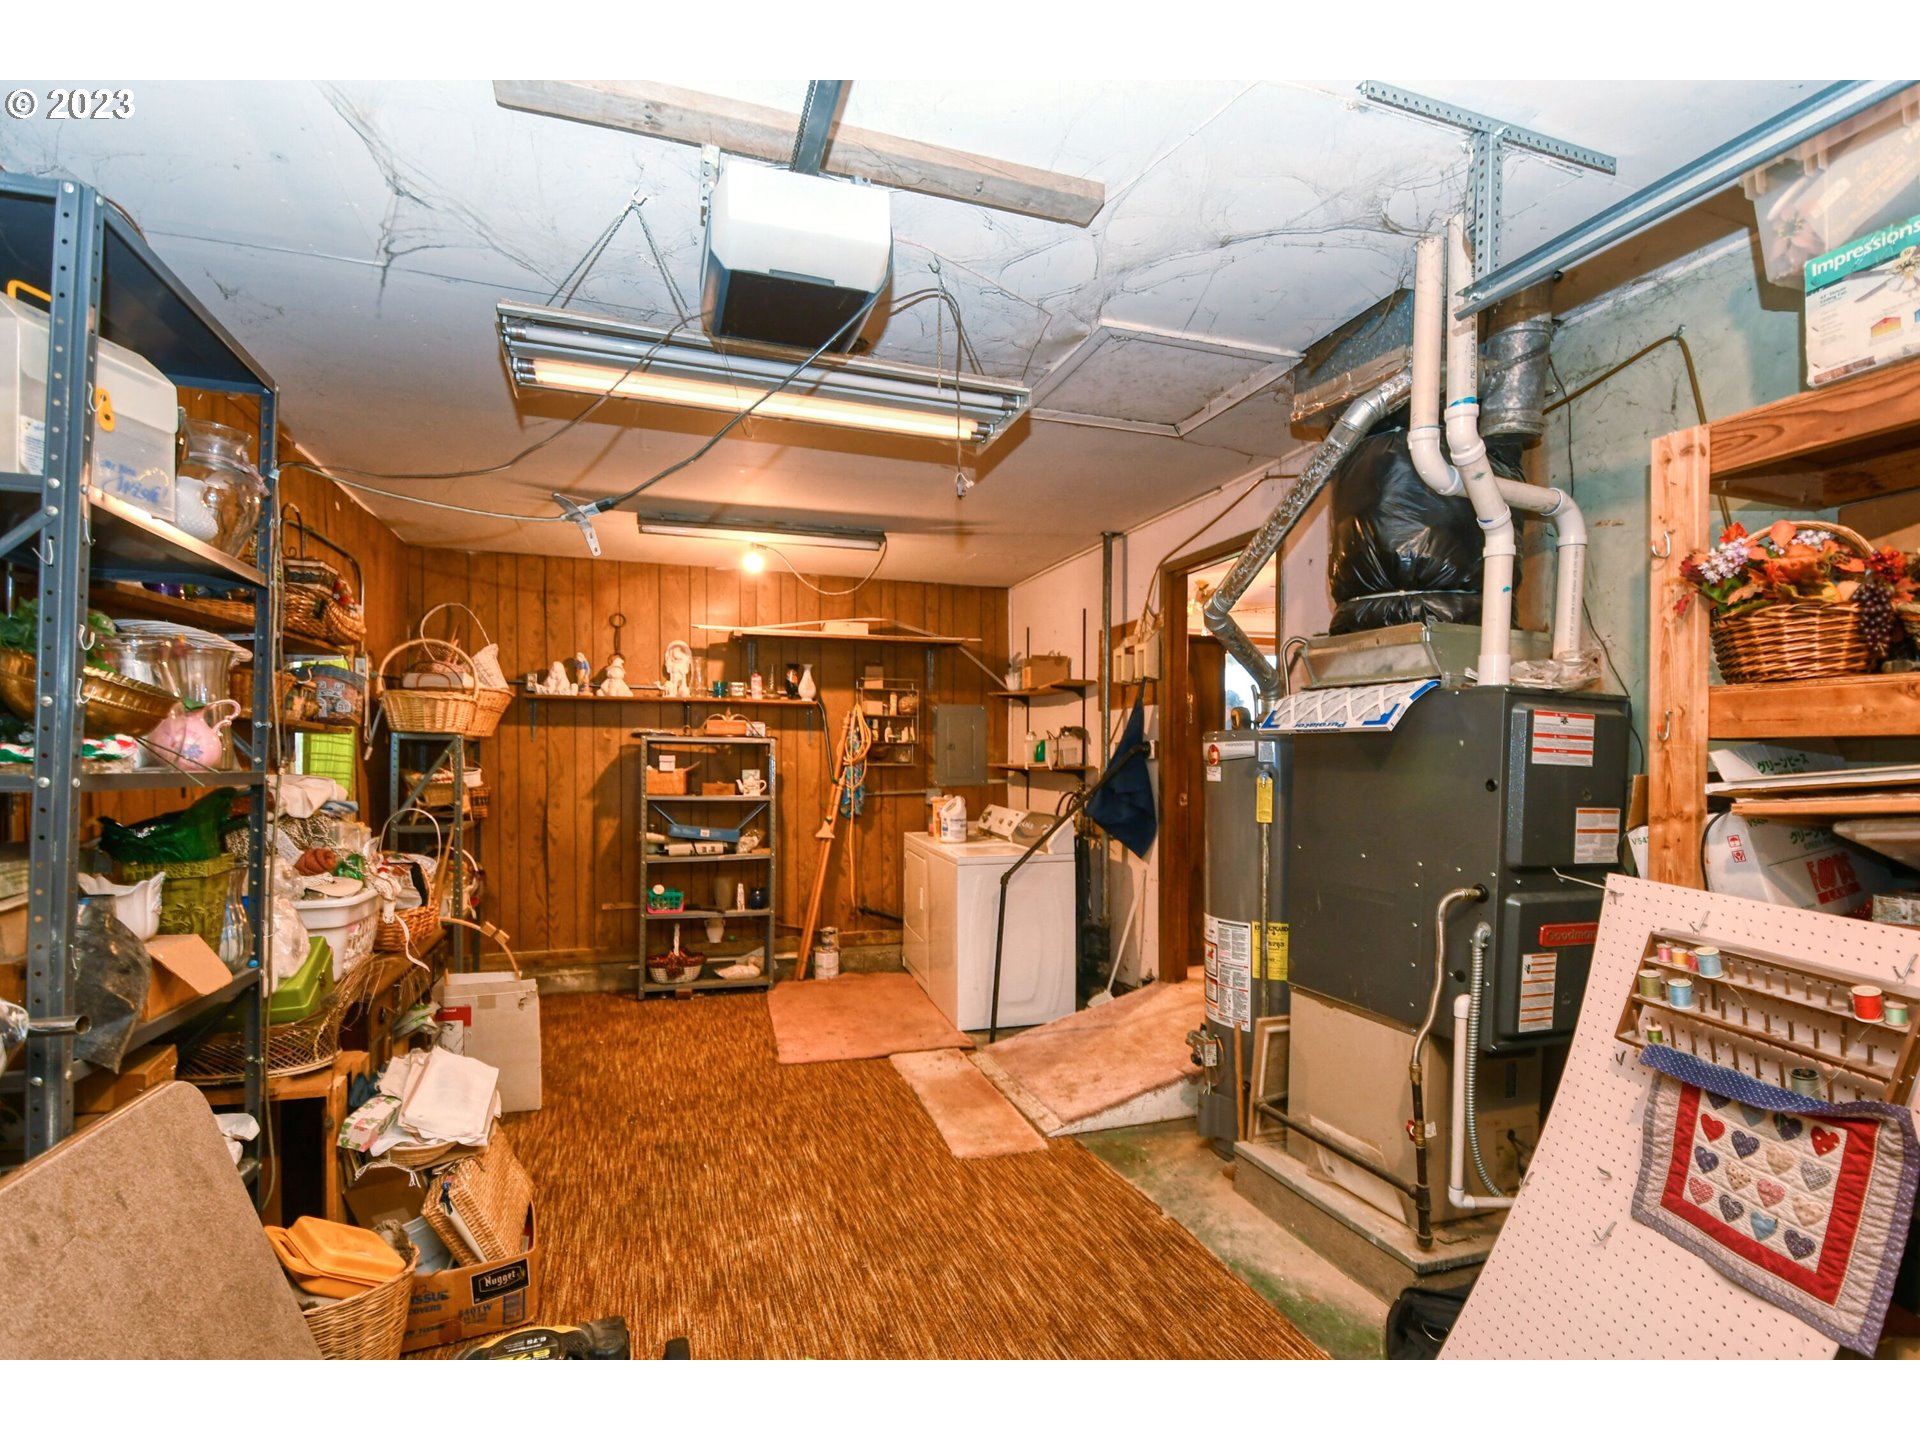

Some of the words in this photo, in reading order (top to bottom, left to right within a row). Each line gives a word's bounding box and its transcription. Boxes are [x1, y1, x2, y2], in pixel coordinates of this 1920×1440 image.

[1812, 222, 1920, 276] Impressions
[1294, 721, 1347, 729] Purolator
[1758, 754, 1809, 774] グリーンピース
[483, 1269, 517, 1288] Nugget
